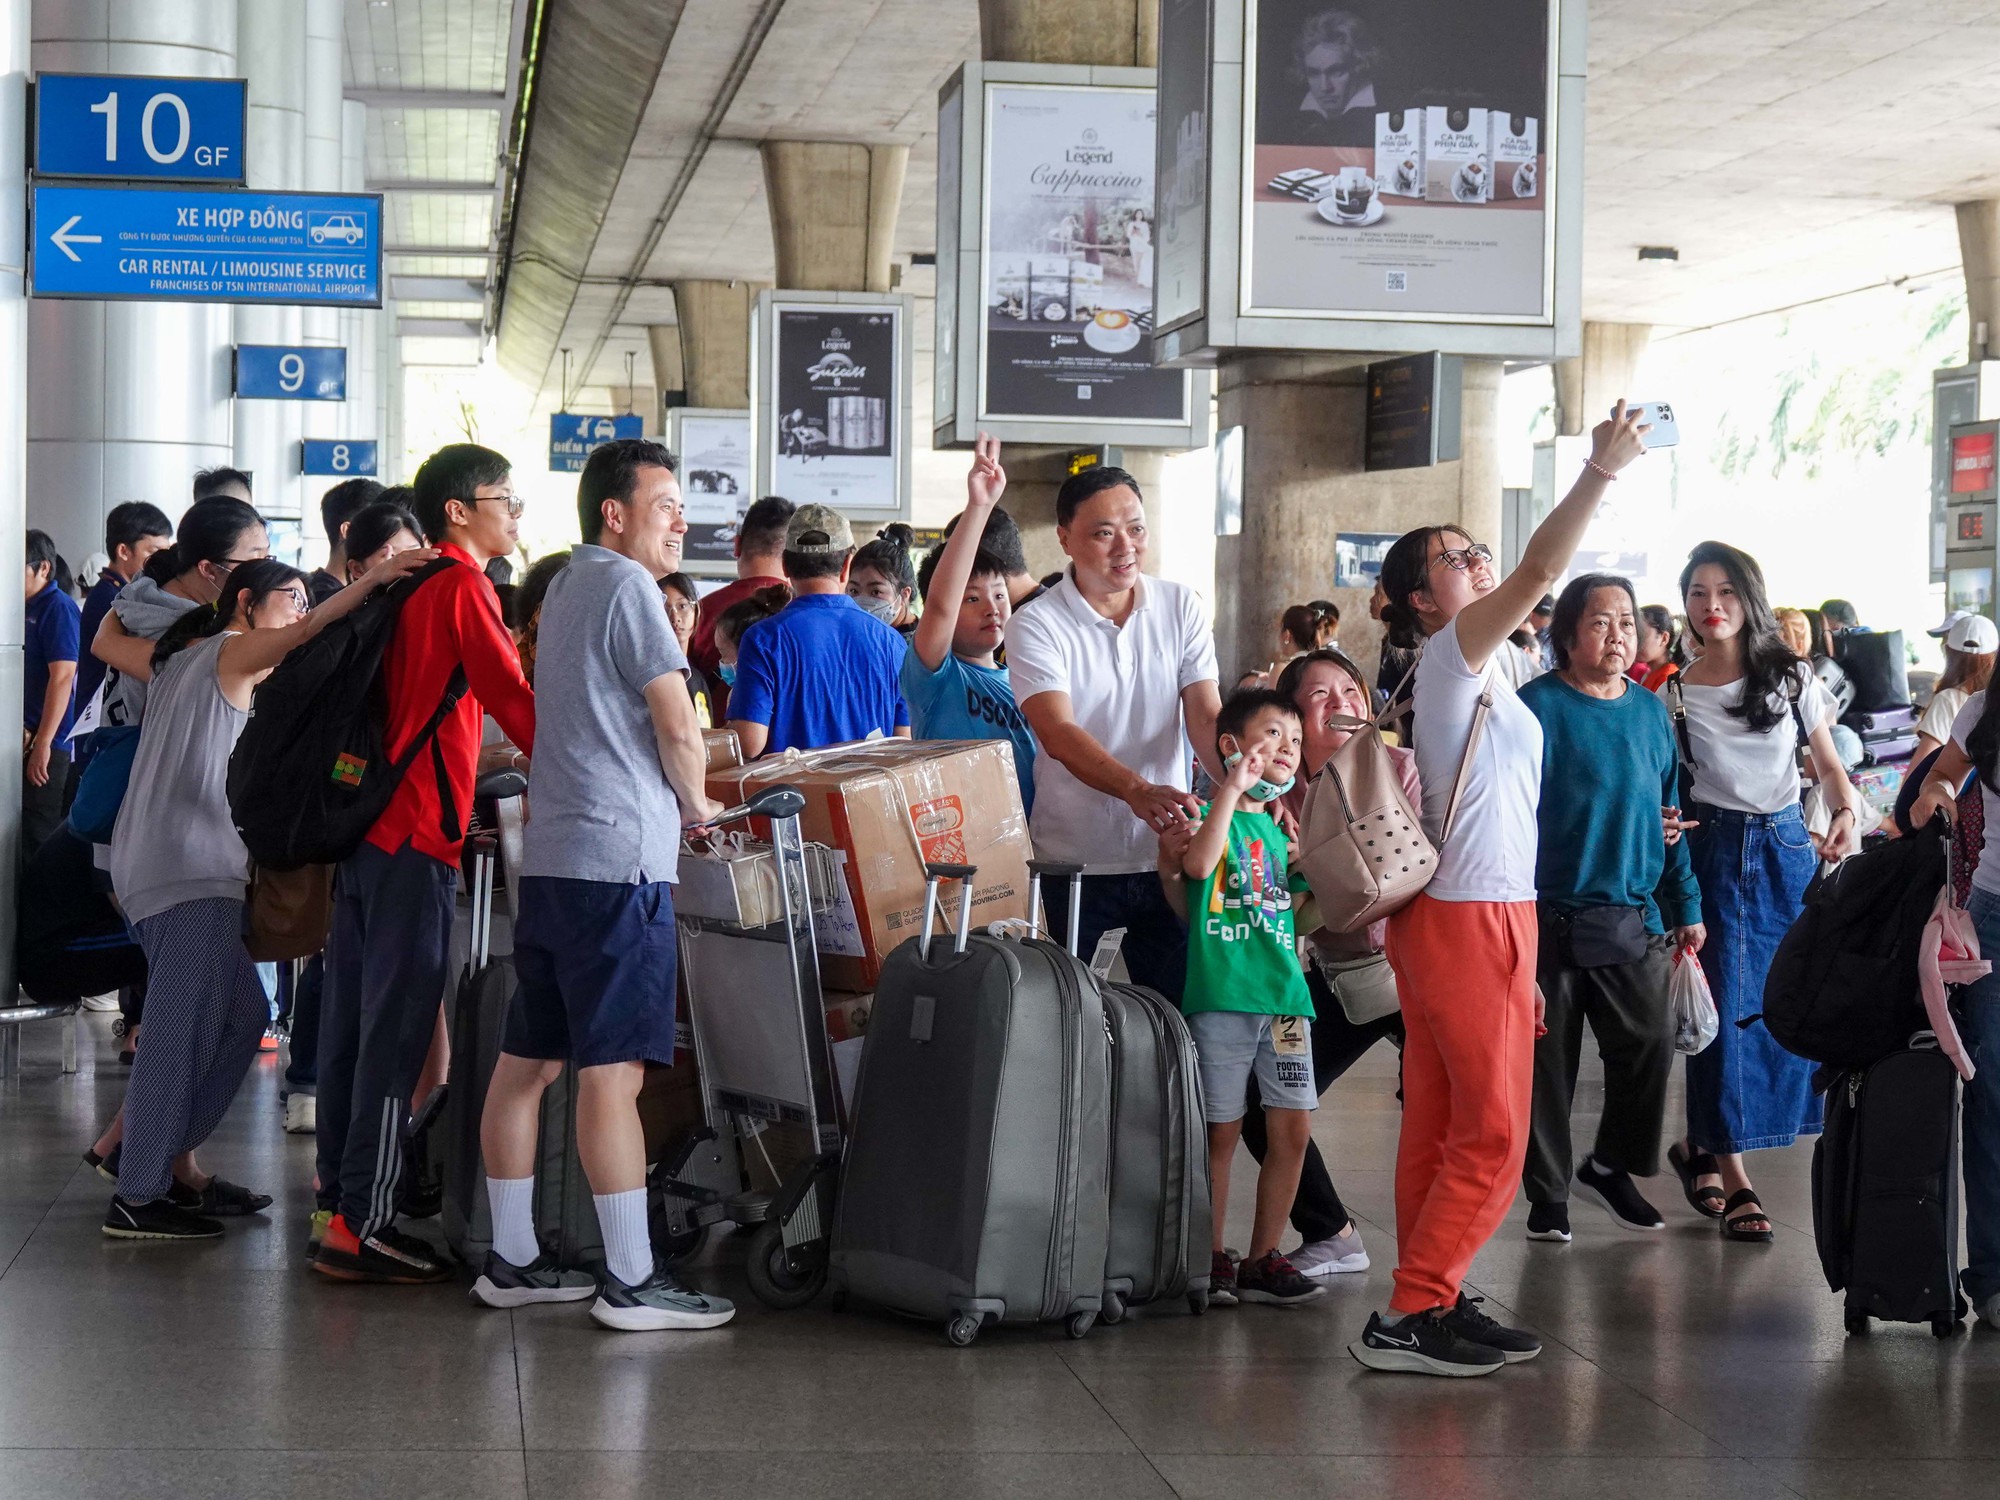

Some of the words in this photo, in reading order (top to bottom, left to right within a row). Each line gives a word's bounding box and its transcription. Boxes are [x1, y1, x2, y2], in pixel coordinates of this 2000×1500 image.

[90, 91, 191, 164] 10
[194, 145, 229, 166] GF
[1066, 150, 1113, 165] Legend
[1030, 163, 1143, 193] Cappuccino
[176, 207, 199, 227] XE
[204, 207, 245, 233] HỢP
[249, 204, 303, 229] ĐỒNG
[119, 258, 148, 274] CAR
[152, 259, 208, 276] RENTAL
[211, 261, 218, 276] /
[222, 261, 304, 278] LIMOUSINE
[307, 263, 367, 279] SERVICE
[150, 279, 209, 291] FRANCHISES
[211, 280, 223, 291] OF
[226, 281, 244, 292] TSN
[246, 281, 322, 293] INTERNATIONAL
[325, 283, 366, 294] AIRPORT
[279, 353, 305, 392] 9
[319, 381, 338, 393] GF
[332, 444, 350, 471] 8
[938, 798, 954, 809] EASY
[981, 882, 1010, 896] PACKING
[1276, 1061, 1308, 1071] FOOTBAL
[1277, 1072, 1309, 1082] LLEAGUE
